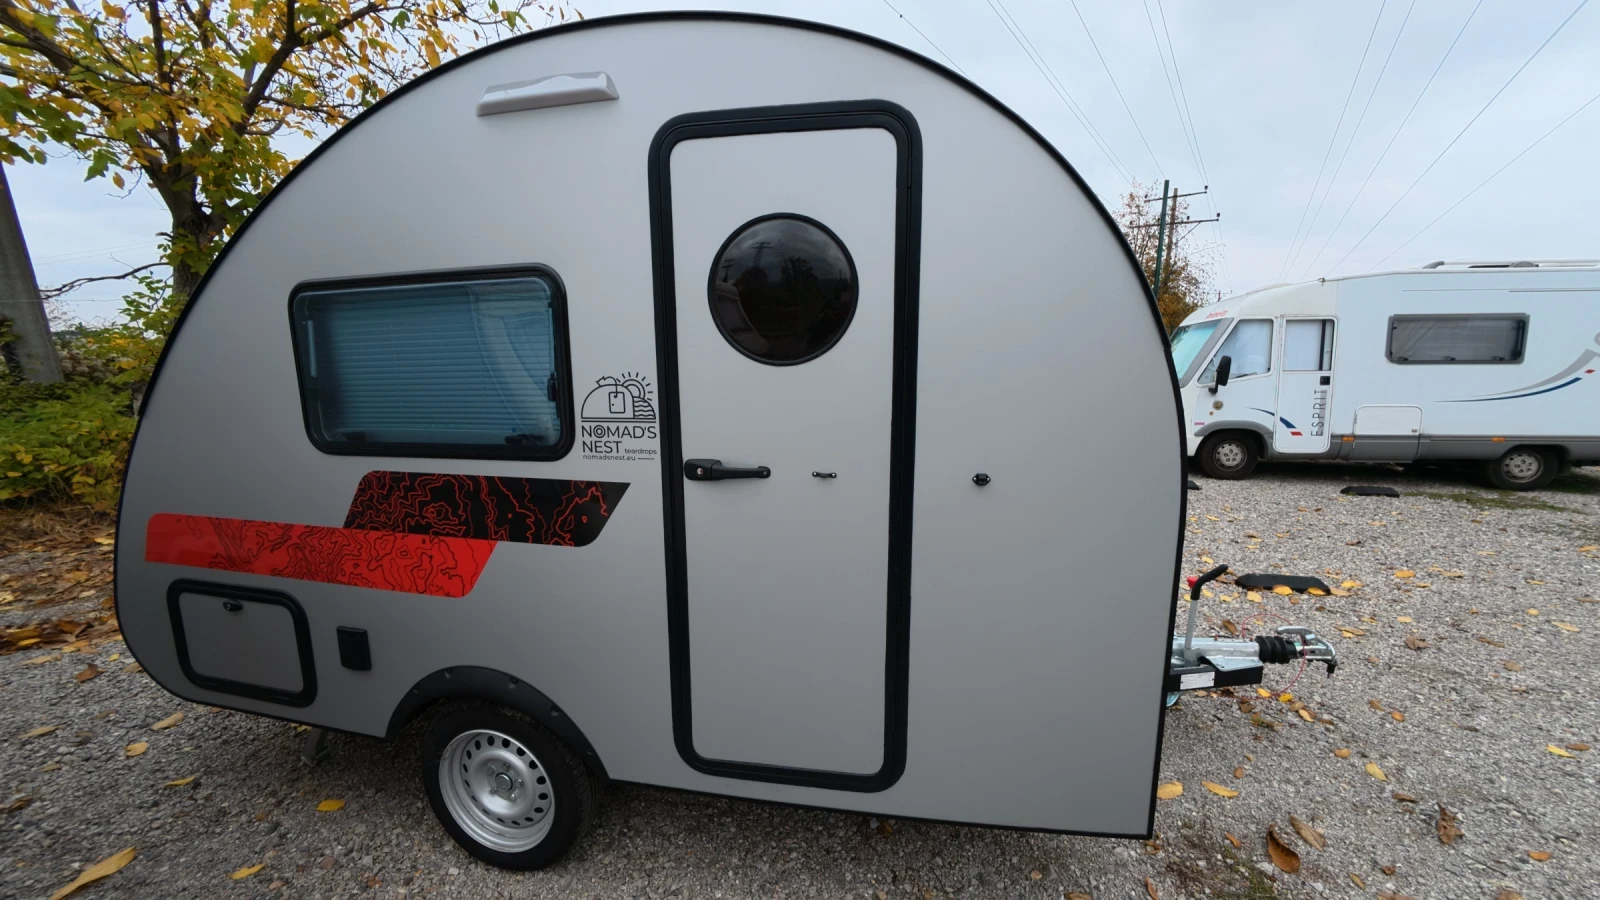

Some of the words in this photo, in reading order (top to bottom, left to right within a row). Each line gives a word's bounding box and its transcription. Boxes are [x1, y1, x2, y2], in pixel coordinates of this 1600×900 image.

[1311, 389, 1327, 436] ESPRIT
[581, 424, 657, 439] NOMAD'S
[582, 440, 622, 454] NEST
[624, 448, 657, 456] teardrops
